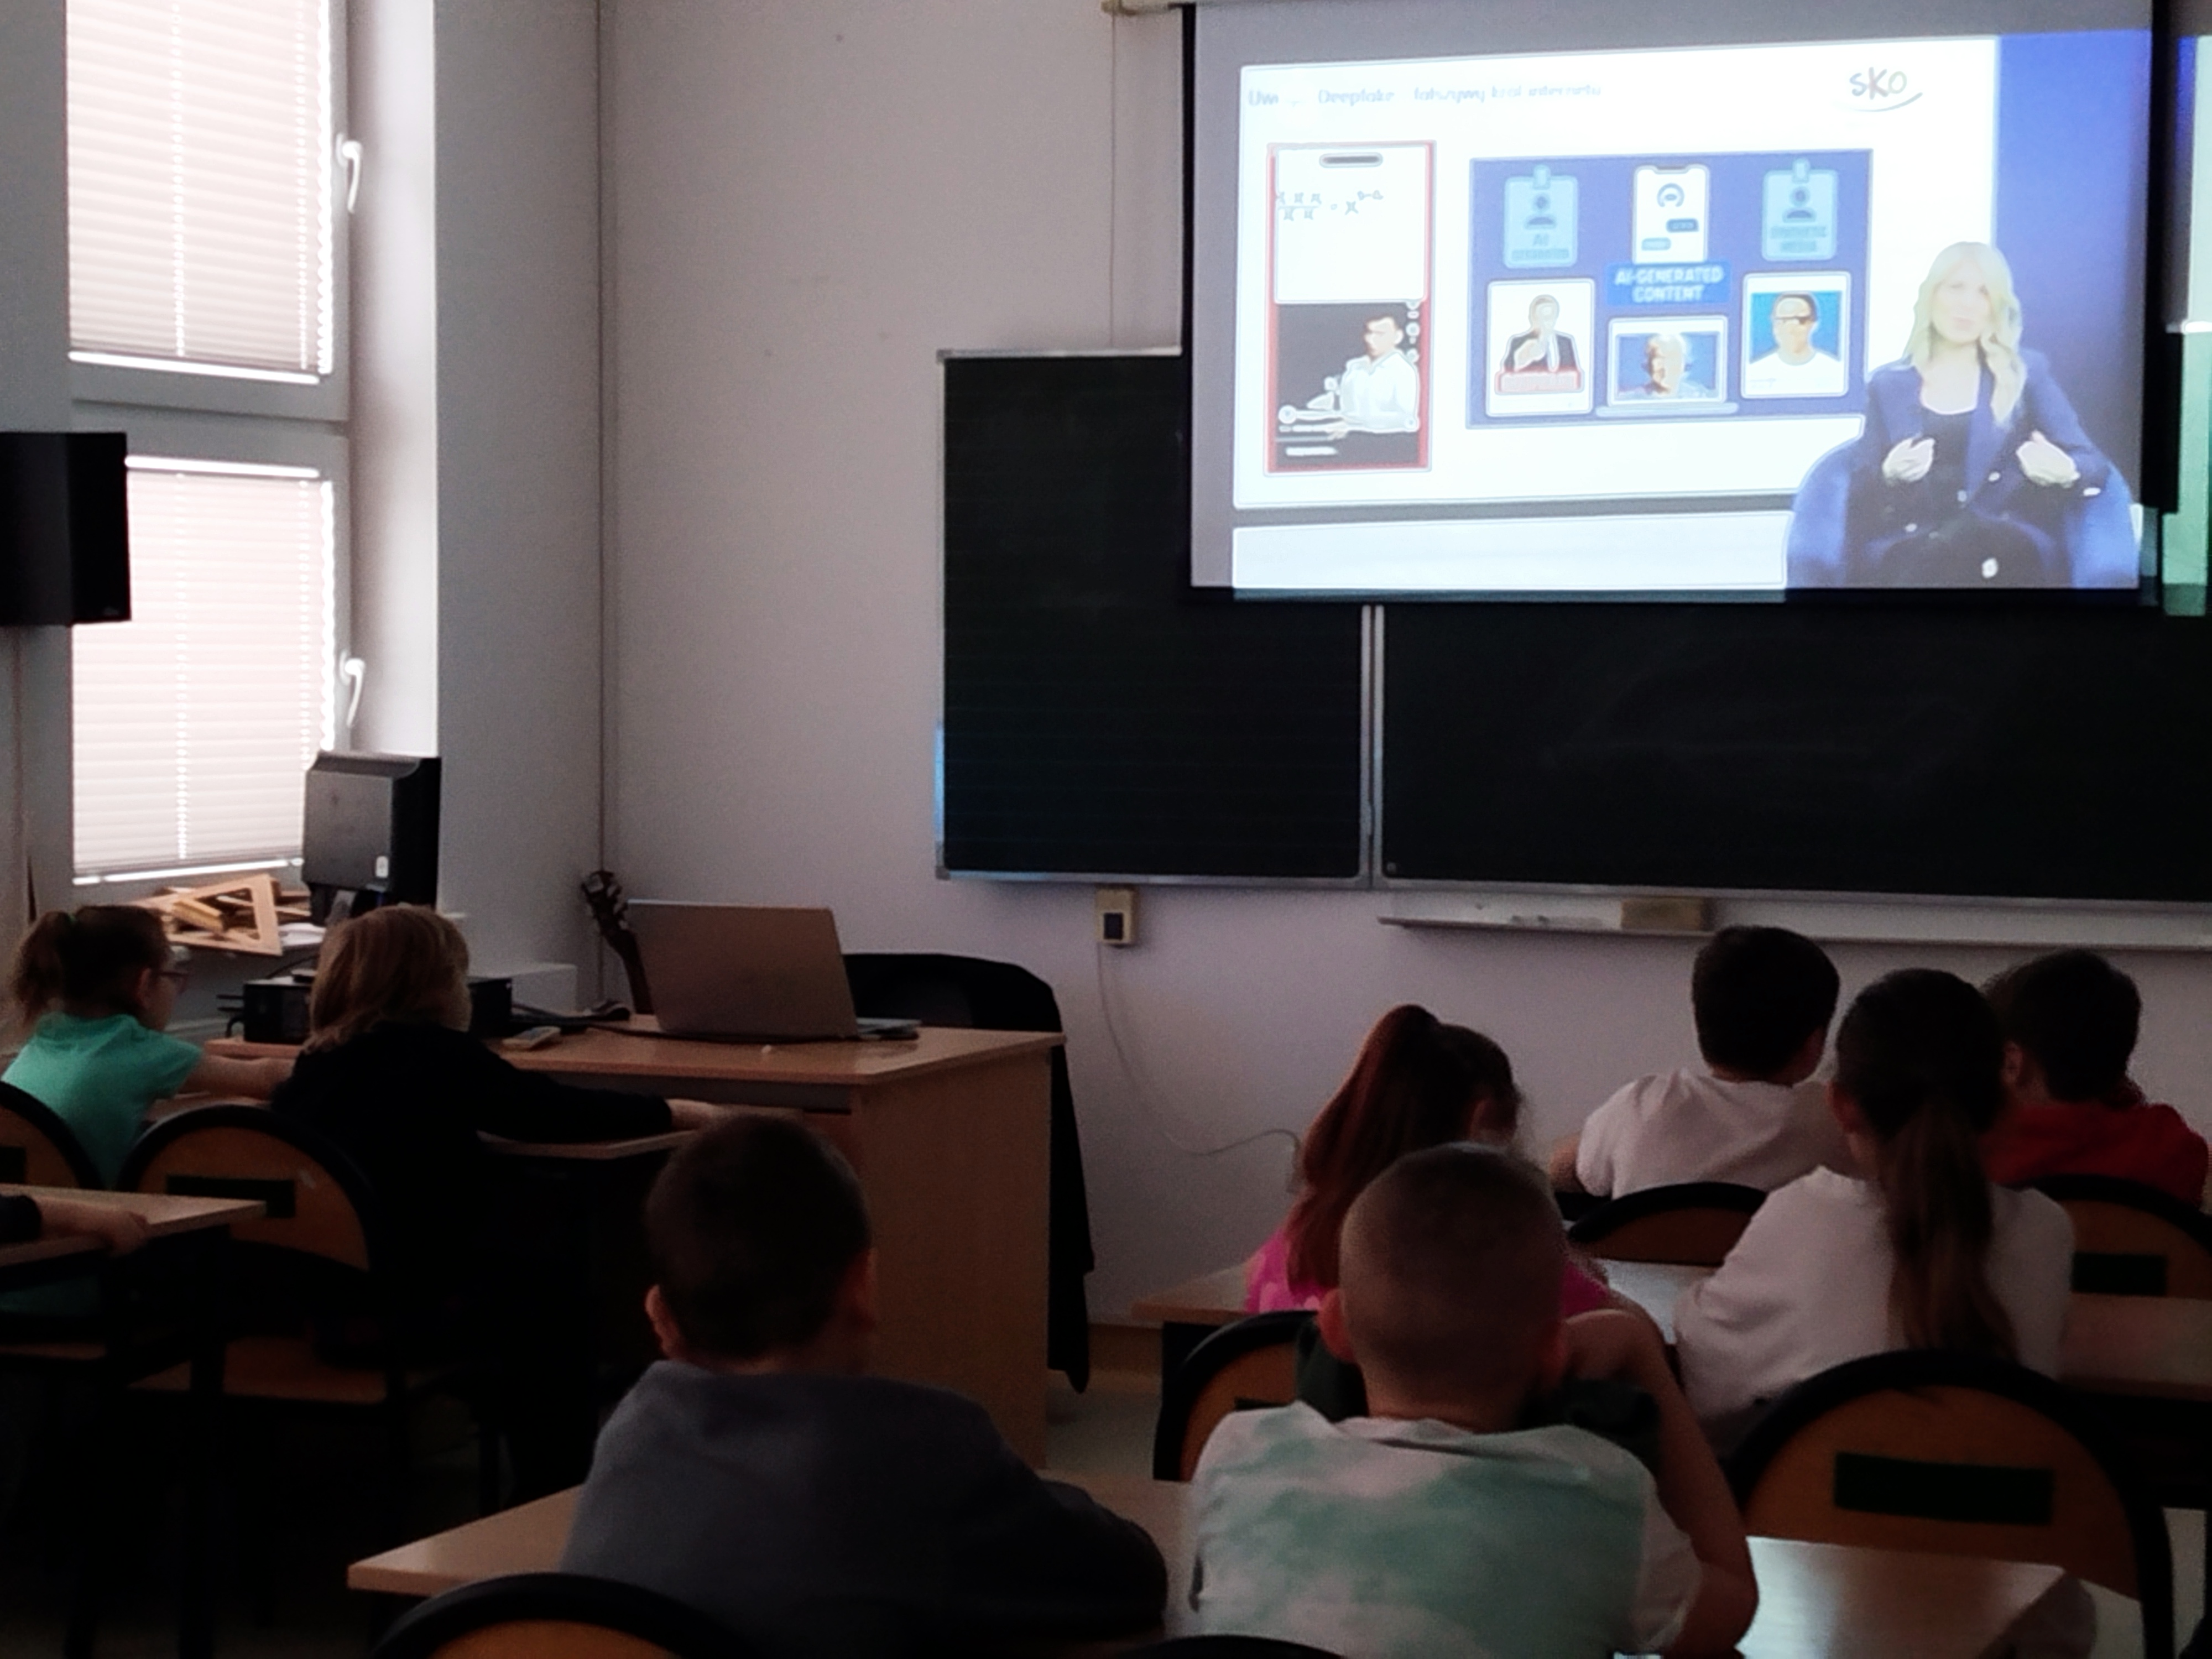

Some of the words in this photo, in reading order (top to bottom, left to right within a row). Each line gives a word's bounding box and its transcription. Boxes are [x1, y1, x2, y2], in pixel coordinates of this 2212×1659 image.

[1849, 66, 1907, 100] SKO
[1615, 265, 1725, 285] AI-GENERATED
[1632, 284, 1704, 303] CONTENT
